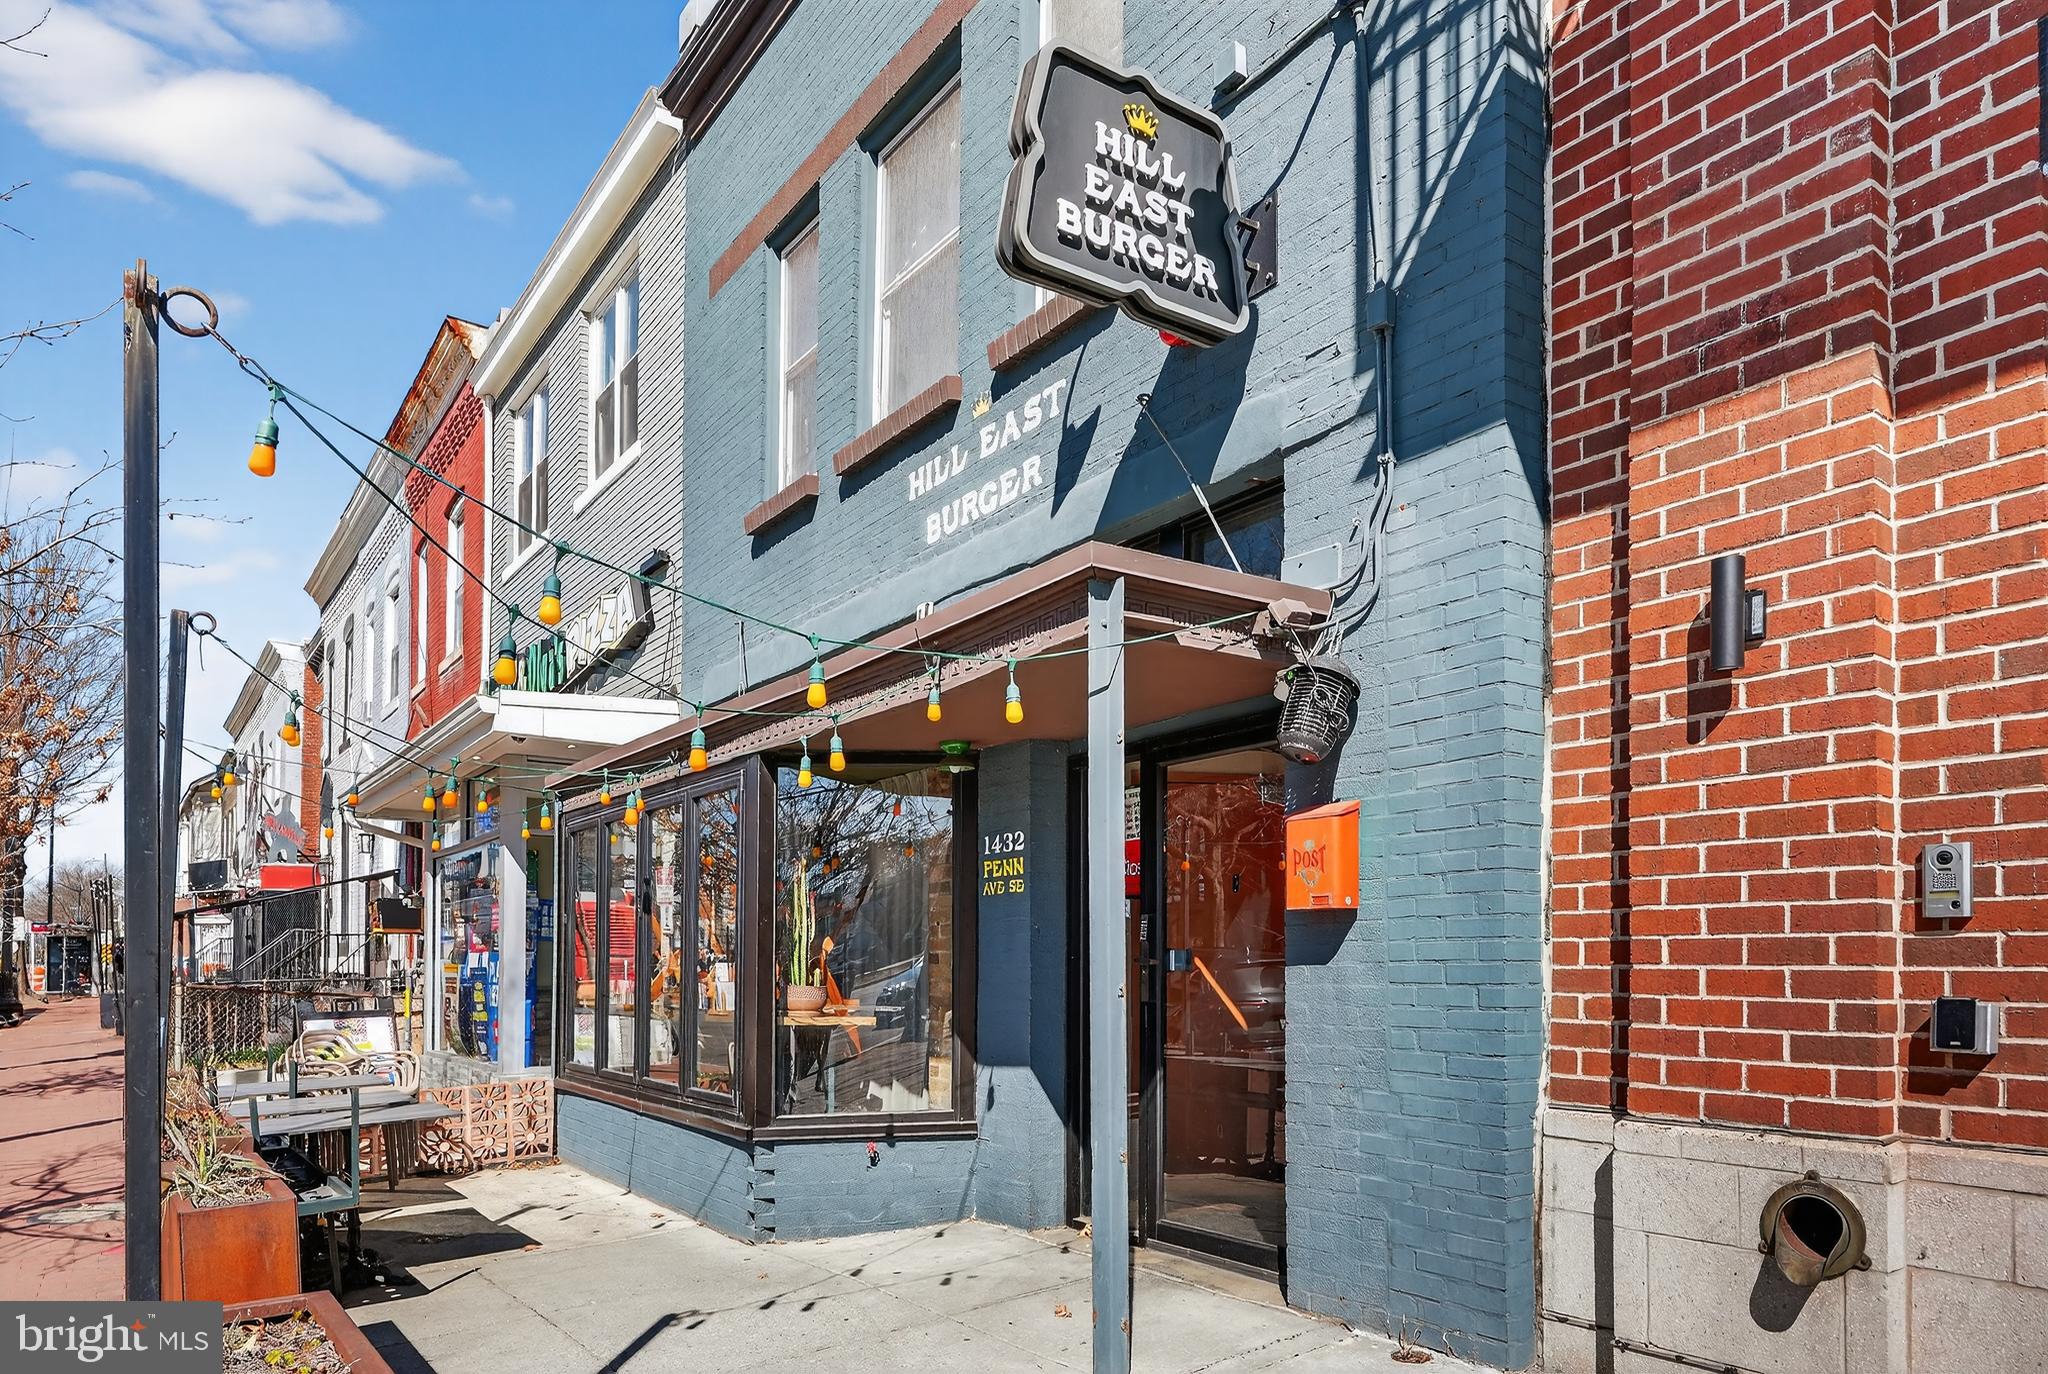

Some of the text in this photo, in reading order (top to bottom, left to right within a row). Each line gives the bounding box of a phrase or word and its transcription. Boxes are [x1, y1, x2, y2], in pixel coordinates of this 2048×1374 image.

[1095, 121, 1186, 188] HILL
[1085, 163, 1194, 235] EAST
[1057, 198, 1218, 290] BURGER
[908, 378, 1067, 501] HILL EAST
[926, 454, 1043, 545] BURGER
[565, 577, 636, 678] PIZZA
[983, 856, 1024, 879] PENN
[984, 830, 1025, 855] 1432
[1293, 844, 1326, 876] POST
[982, 878, 1025, 896] AVE SE
